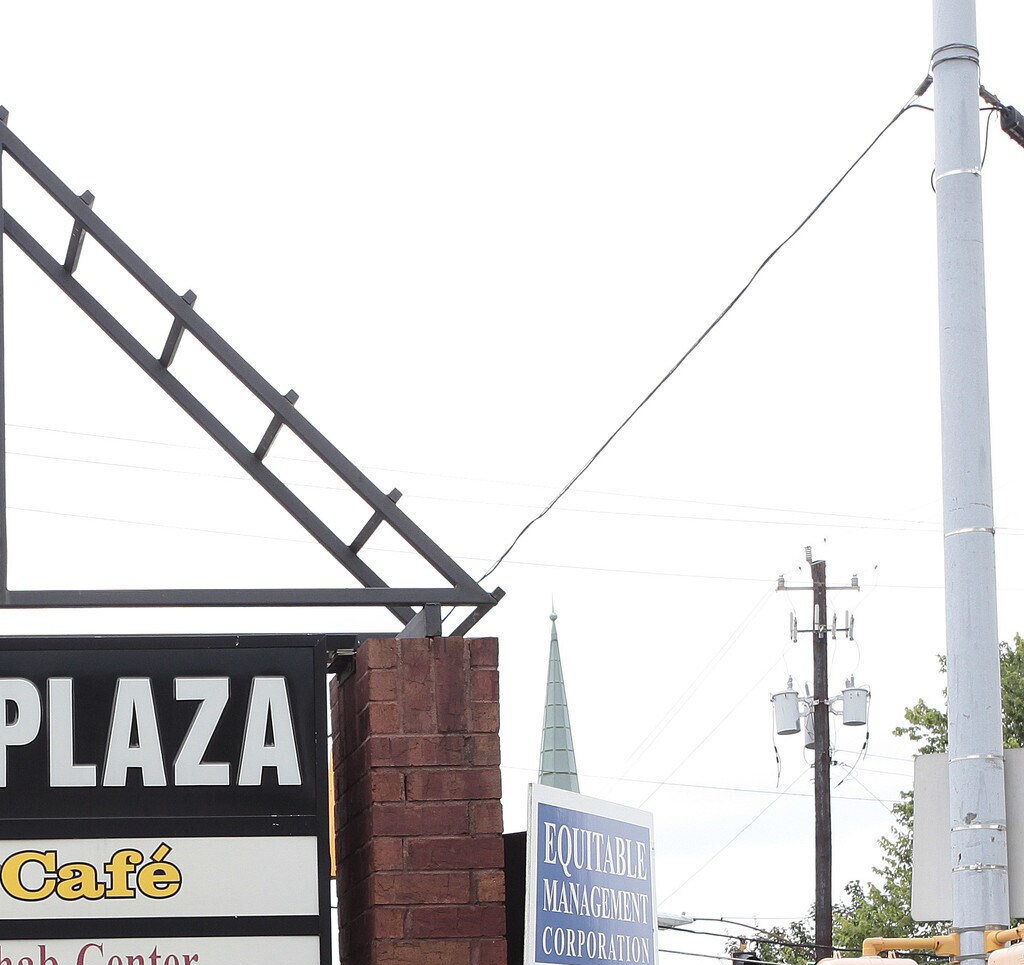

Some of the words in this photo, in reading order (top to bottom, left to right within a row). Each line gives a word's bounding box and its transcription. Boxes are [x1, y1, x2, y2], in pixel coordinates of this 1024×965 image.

[543, 821, 648, 881] EQUITABLE
[542, 878, 649, 926] MANAGEMENT
[542, 925, 650, 964] CORPORATION
